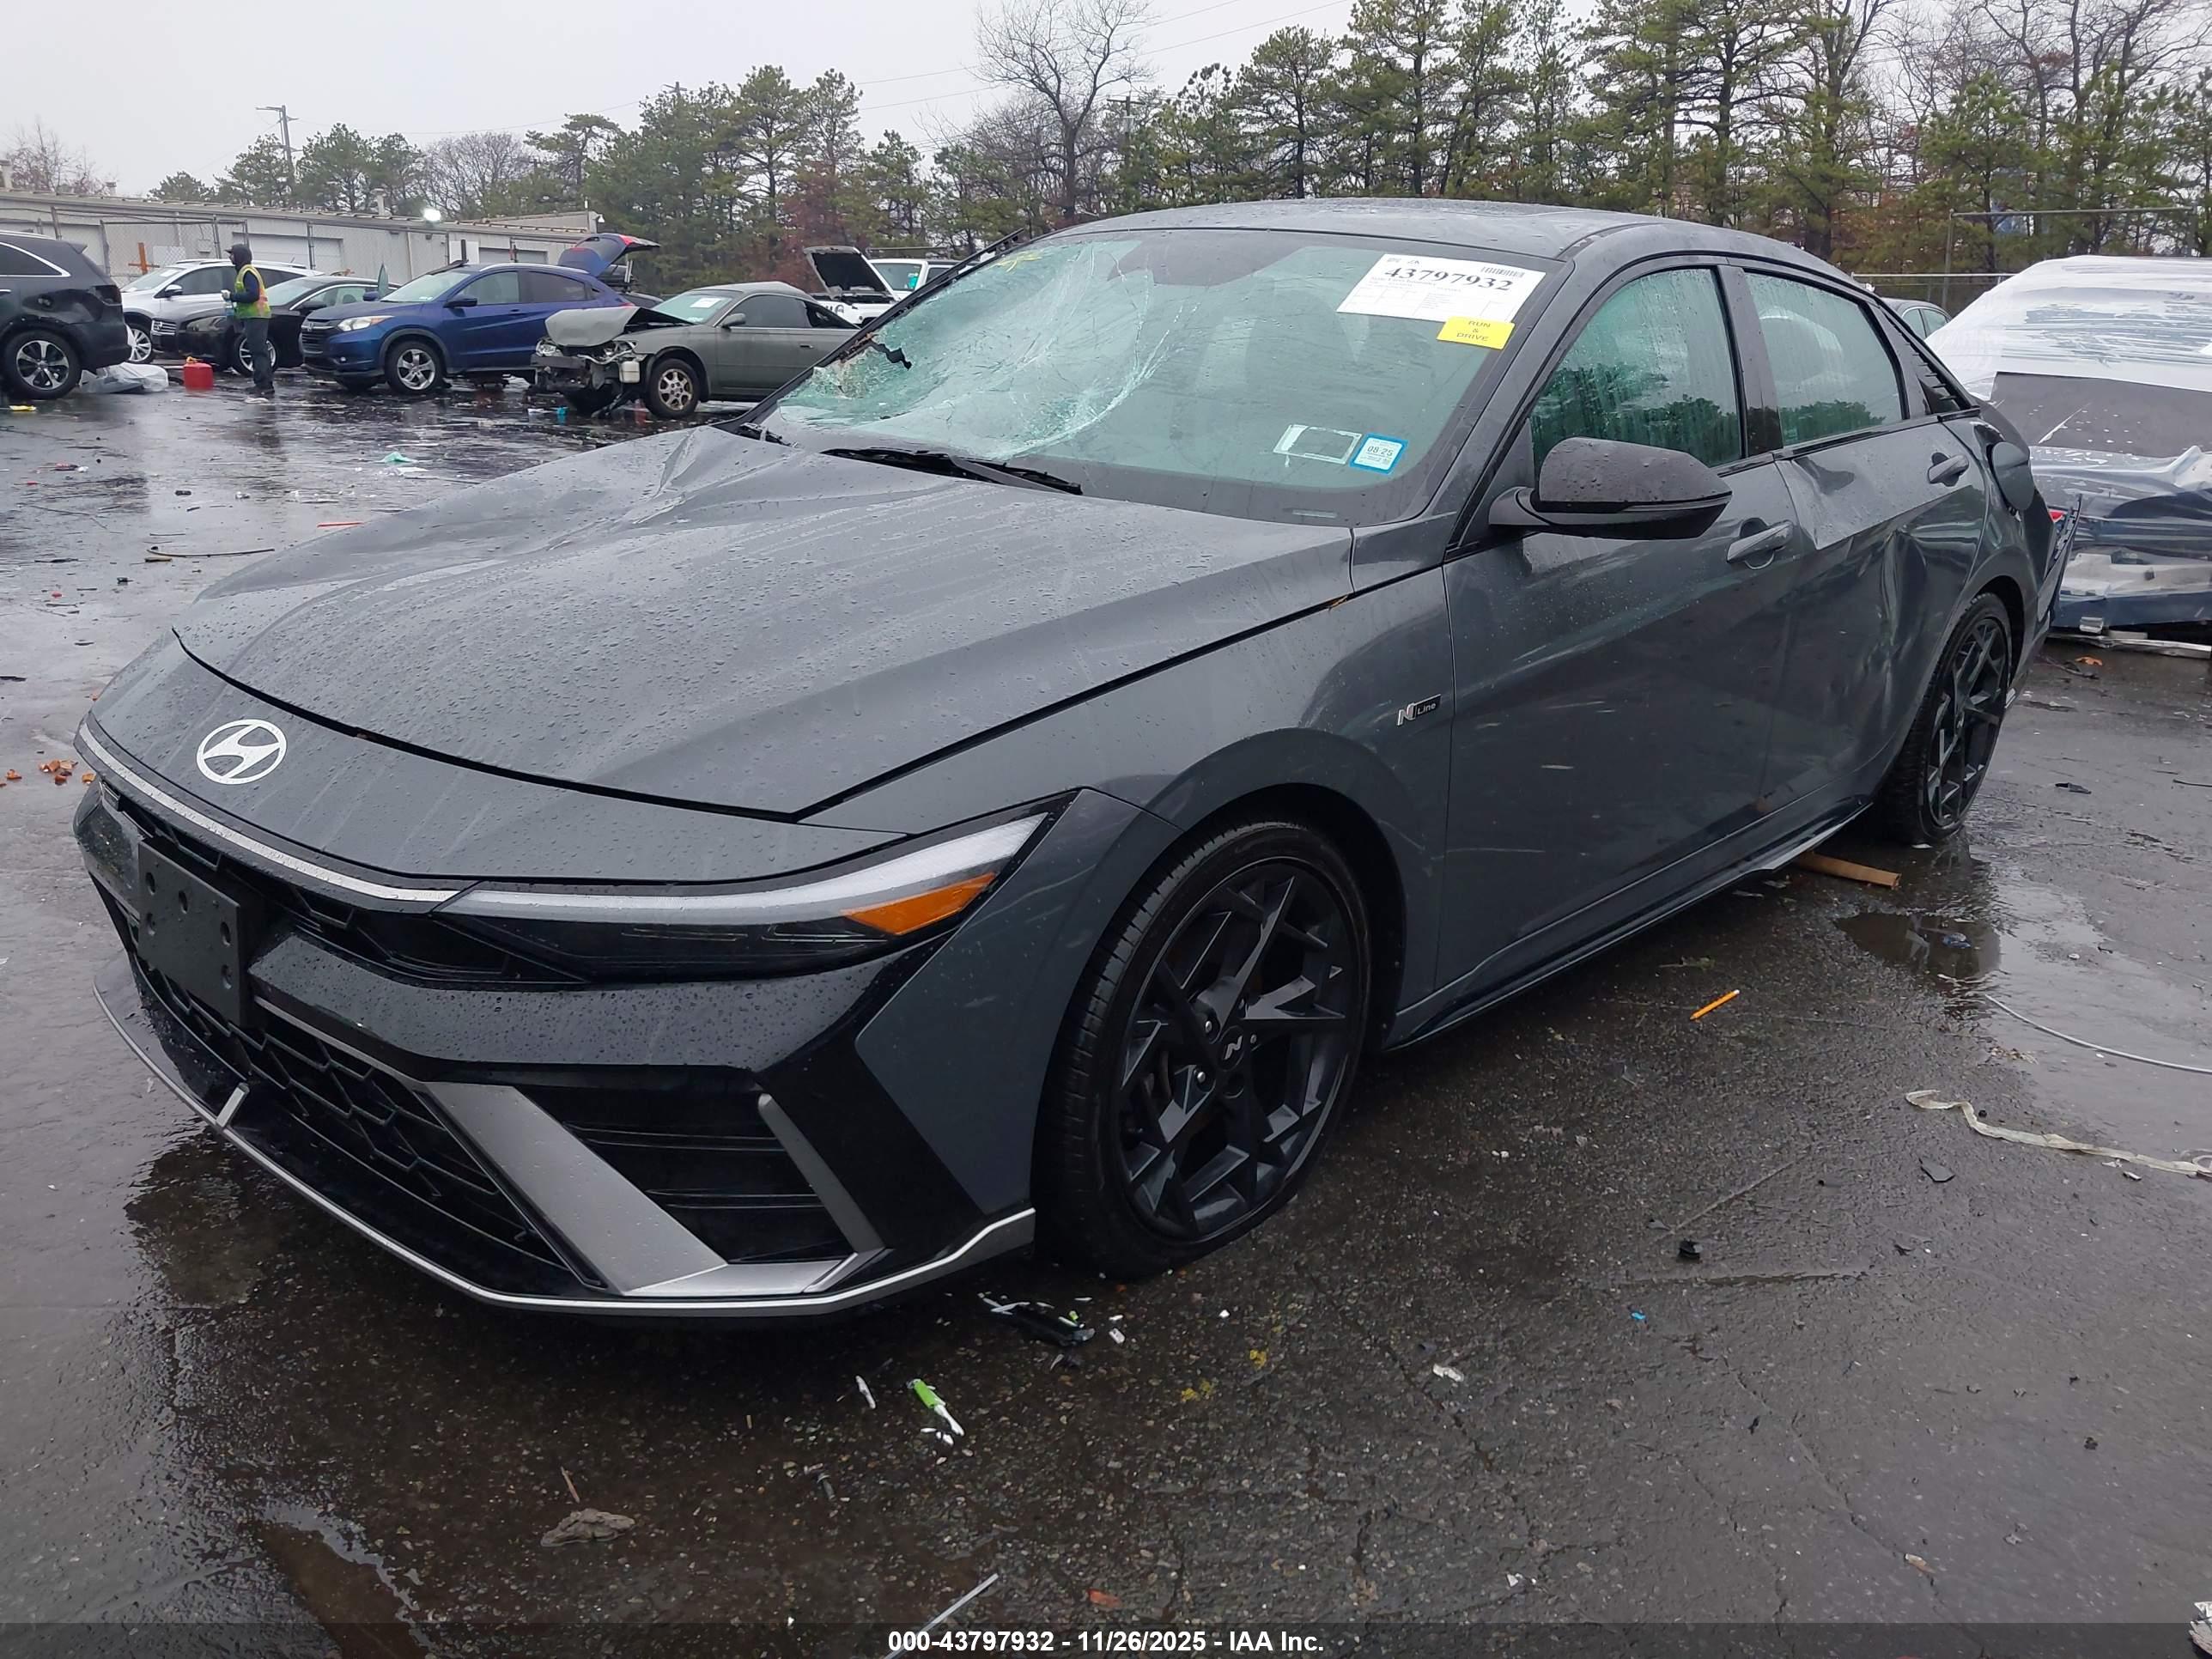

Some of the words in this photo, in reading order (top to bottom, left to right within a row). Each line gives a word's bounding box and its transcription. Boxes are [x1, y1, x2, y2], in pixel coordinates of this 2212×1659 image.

[1384, 267, 1514, 291] 43797932
[1456, 332, 1489, 342] DRIVE
[1396, 702, 1416, 726] N
[1224, 1035, 1243, 1060] N
